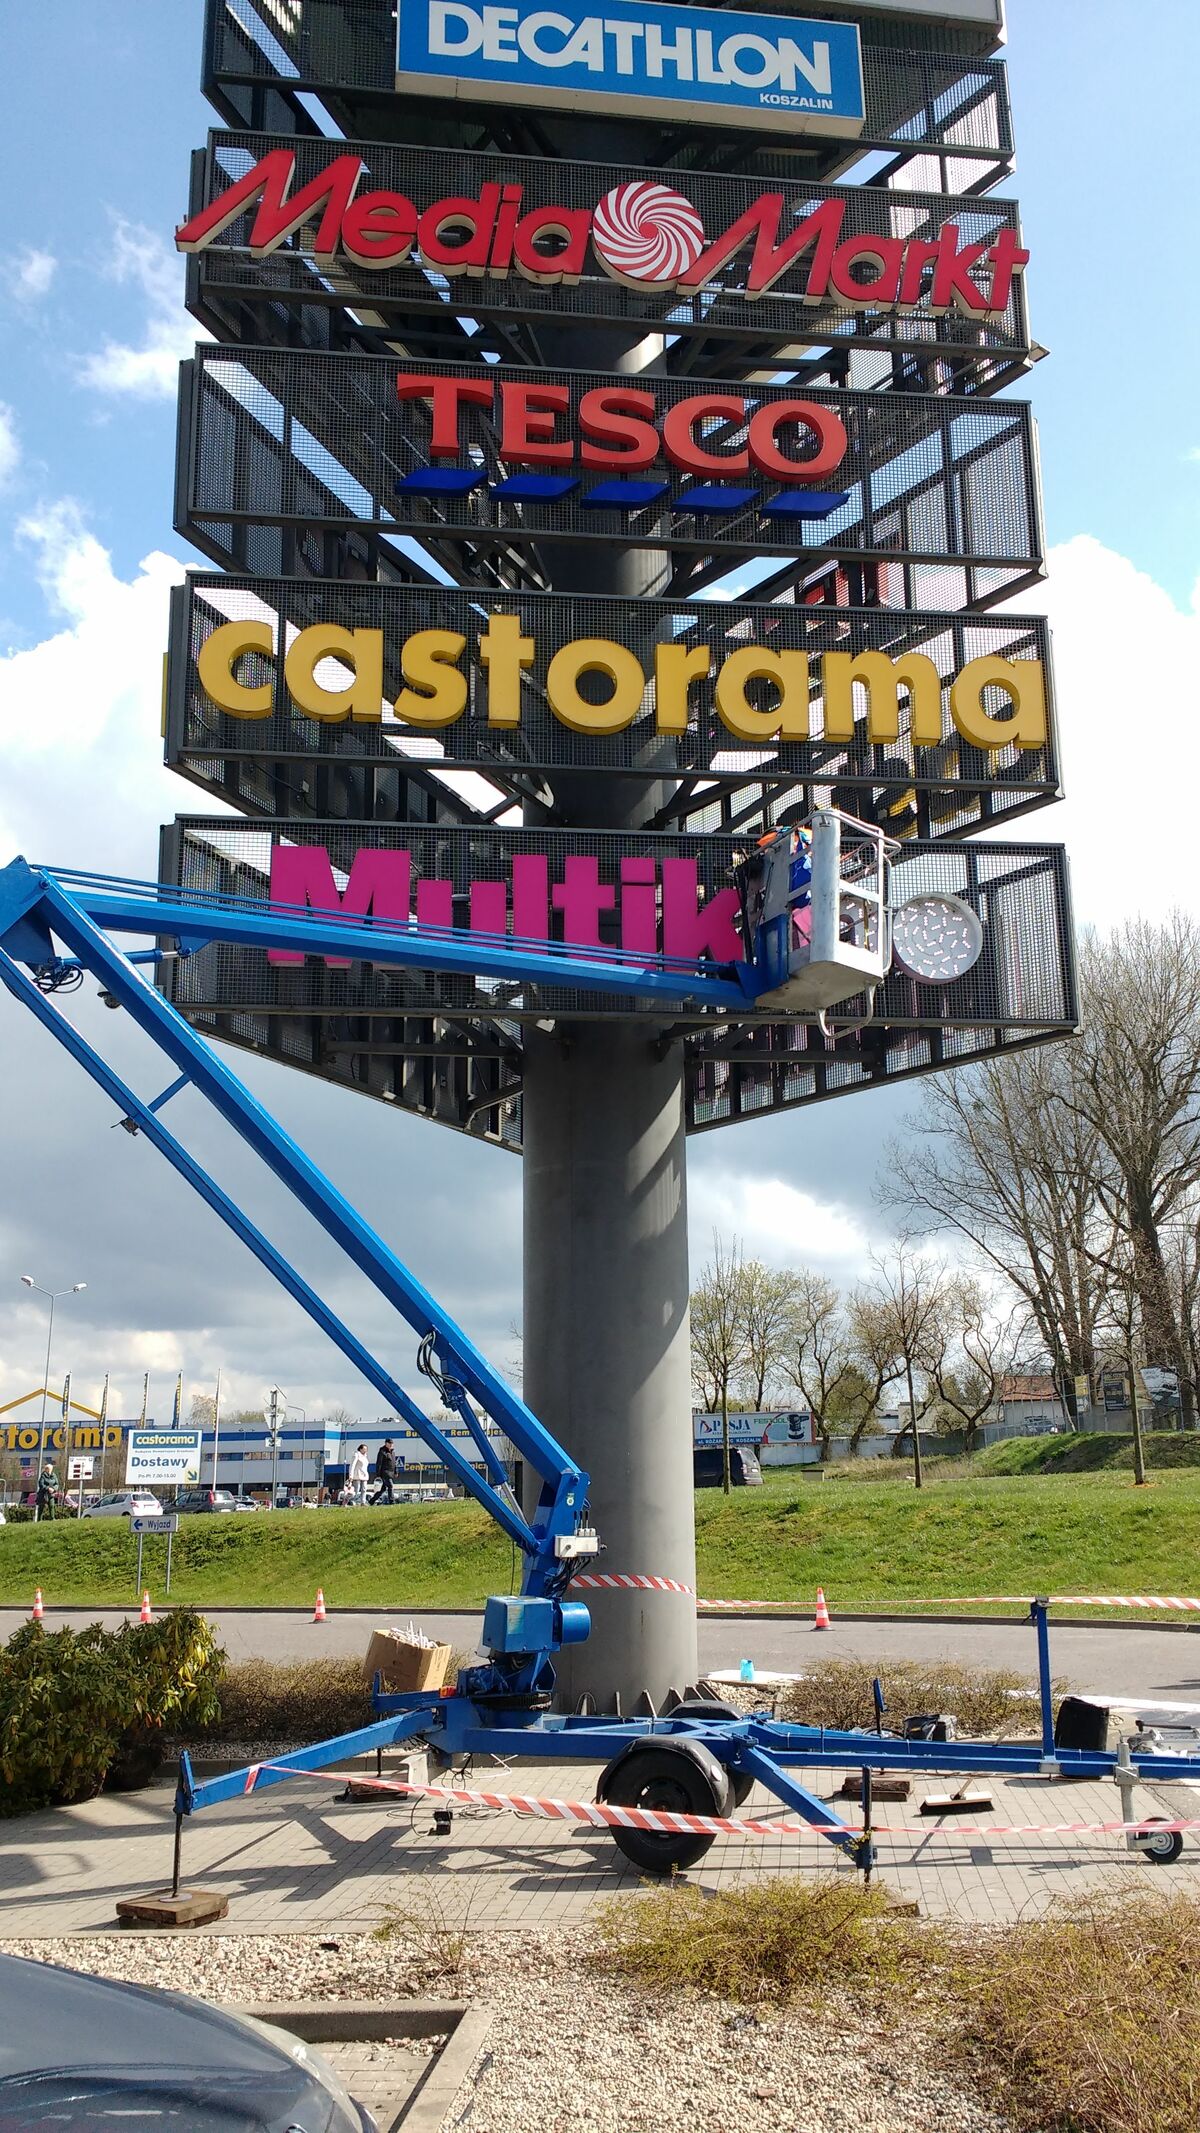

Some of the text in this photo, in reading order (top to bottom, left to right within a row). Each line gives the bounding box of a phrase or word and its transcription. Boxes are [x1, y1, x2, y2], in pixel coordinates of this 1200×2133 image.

[428, 0, 833, 95] DECATHLON
[759, 92, 834, 111] KOSZALIN
[175, 147, 1032, 320] Media Markt
[396, 372, 848, 483] TESCO
[198, 614, 1046, 751] castorama
[266, 844, 811, 972] Multik
[136, 1433, 195, 1445] castorama
[713, 1419, 751, 1431] PSJA
[131, 1456, 189, 1469] Dostawy
[147, 1519, 172, 1531] Wyjazd
